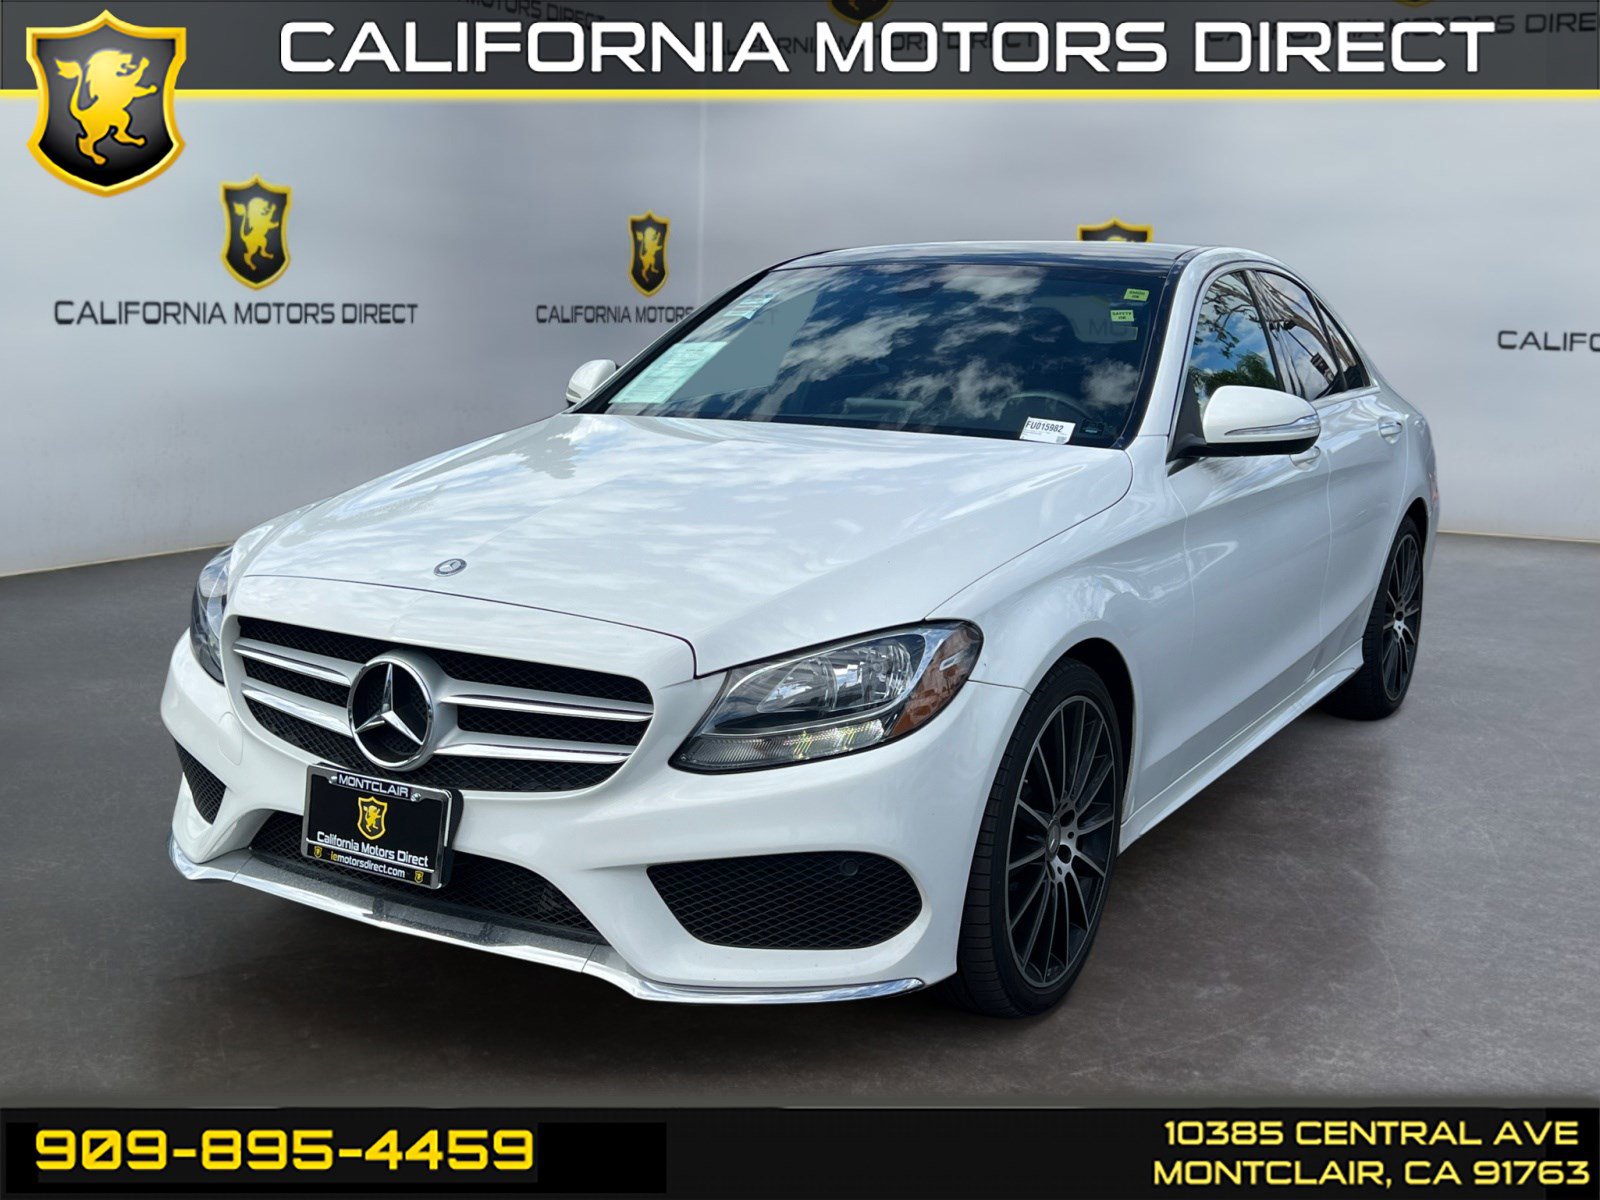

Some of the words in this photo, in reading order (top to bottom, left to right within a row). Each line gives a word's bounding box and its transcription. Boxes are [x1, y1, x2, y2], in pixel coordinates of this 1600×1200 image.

[54, 300, 227, 325] CALIFORNIA
[234, 302, 336, 325] MOTORS
[341, 303, 419, 325] DIRECT
[536, 304, 632, 324] CALIFORNIA
[1025, 420, 1064, 433] FU015982
[339, 774, 409, 798] MONTCLAIR
[316, 831, 360, 852] California
[361, 842, 396, 860] Motors
[397, 850, 429, 868] Direct
[330, 851, 406, 879] iemotorsdirect.com
